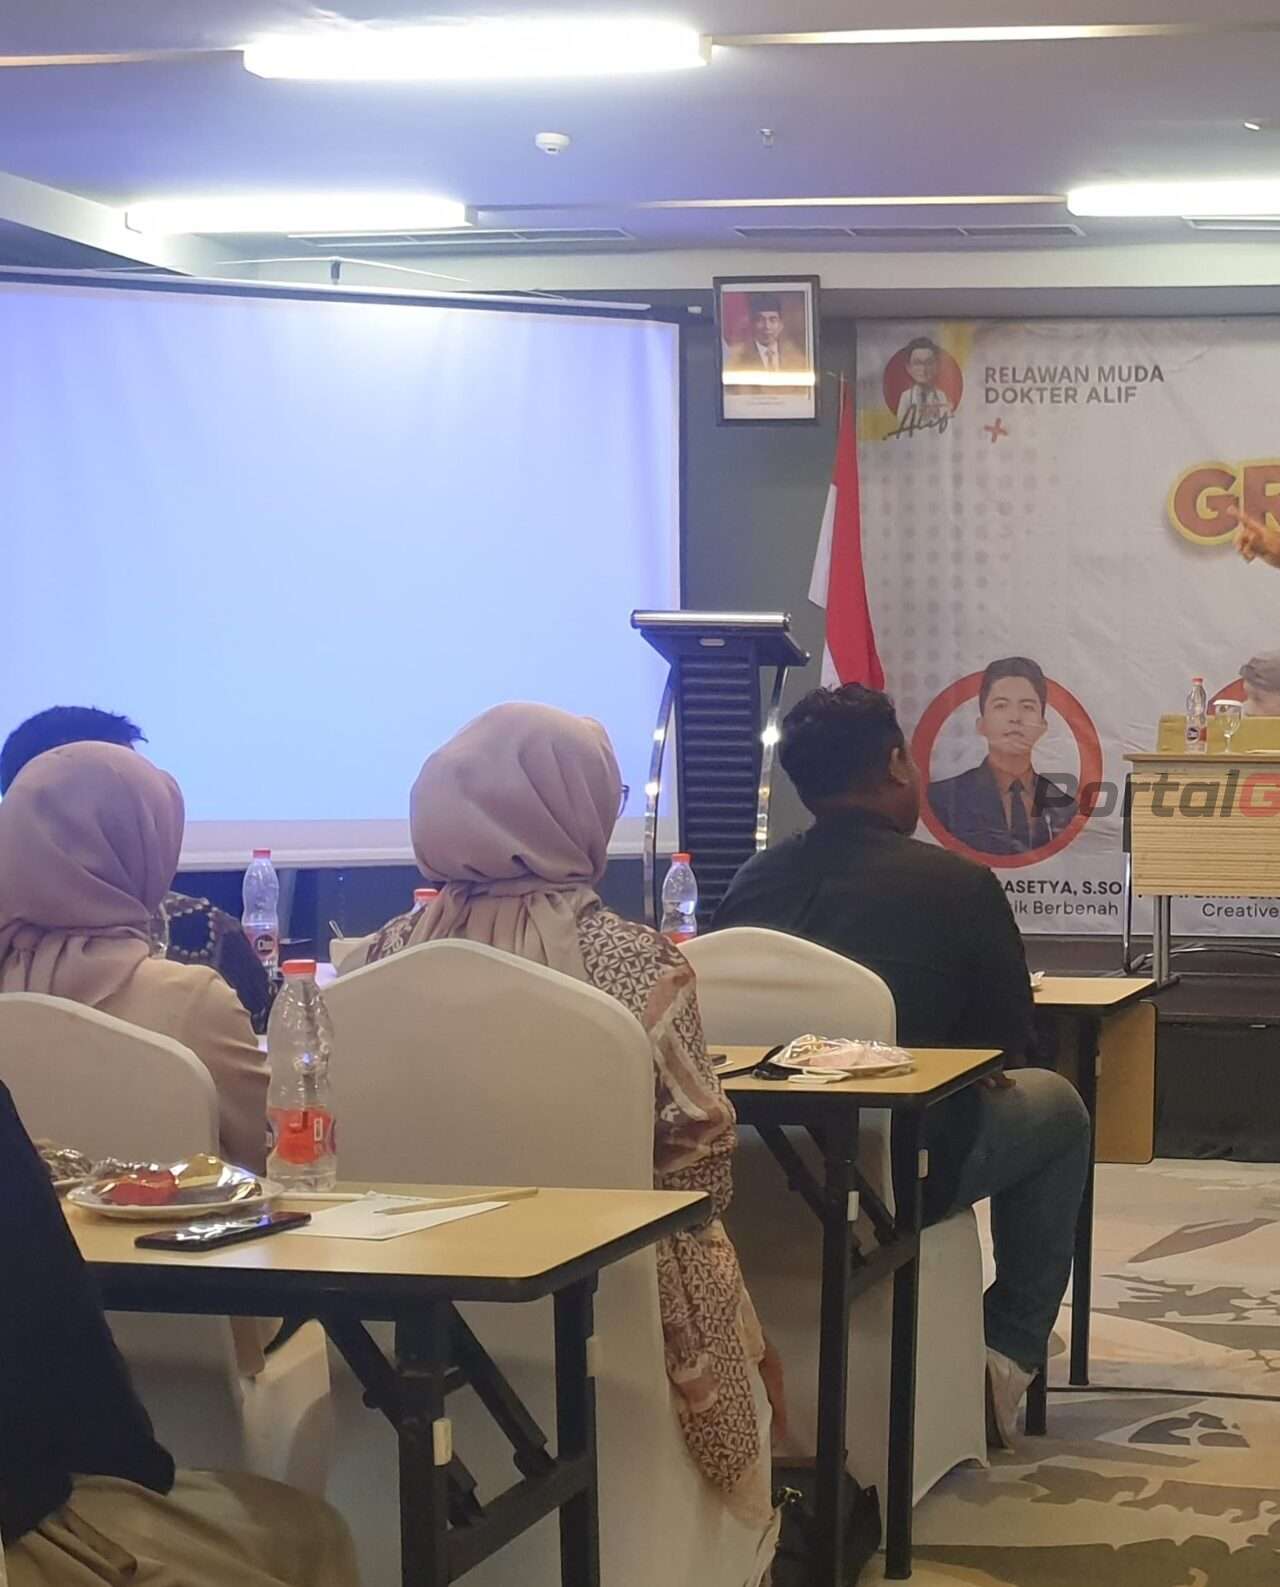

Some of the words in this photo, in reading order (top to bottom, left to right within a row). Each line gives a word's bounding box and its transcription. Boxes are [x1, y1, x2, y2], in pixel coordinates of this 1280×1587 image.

[984, 366, 1089, 384] RELAWAN
[1097, 365, 1165, 383] MUDA
[984, 387, 1079, 404] DOKTER
[1086, 386, 1138, 403] ALIF
[1003, 880, 1078, 896] ASETYA,
[1082, 880, 1122, 895] S.SO
[1033, 900, 1119, 915] Berbenah
[1202, 903, 1279, 918] Creative
